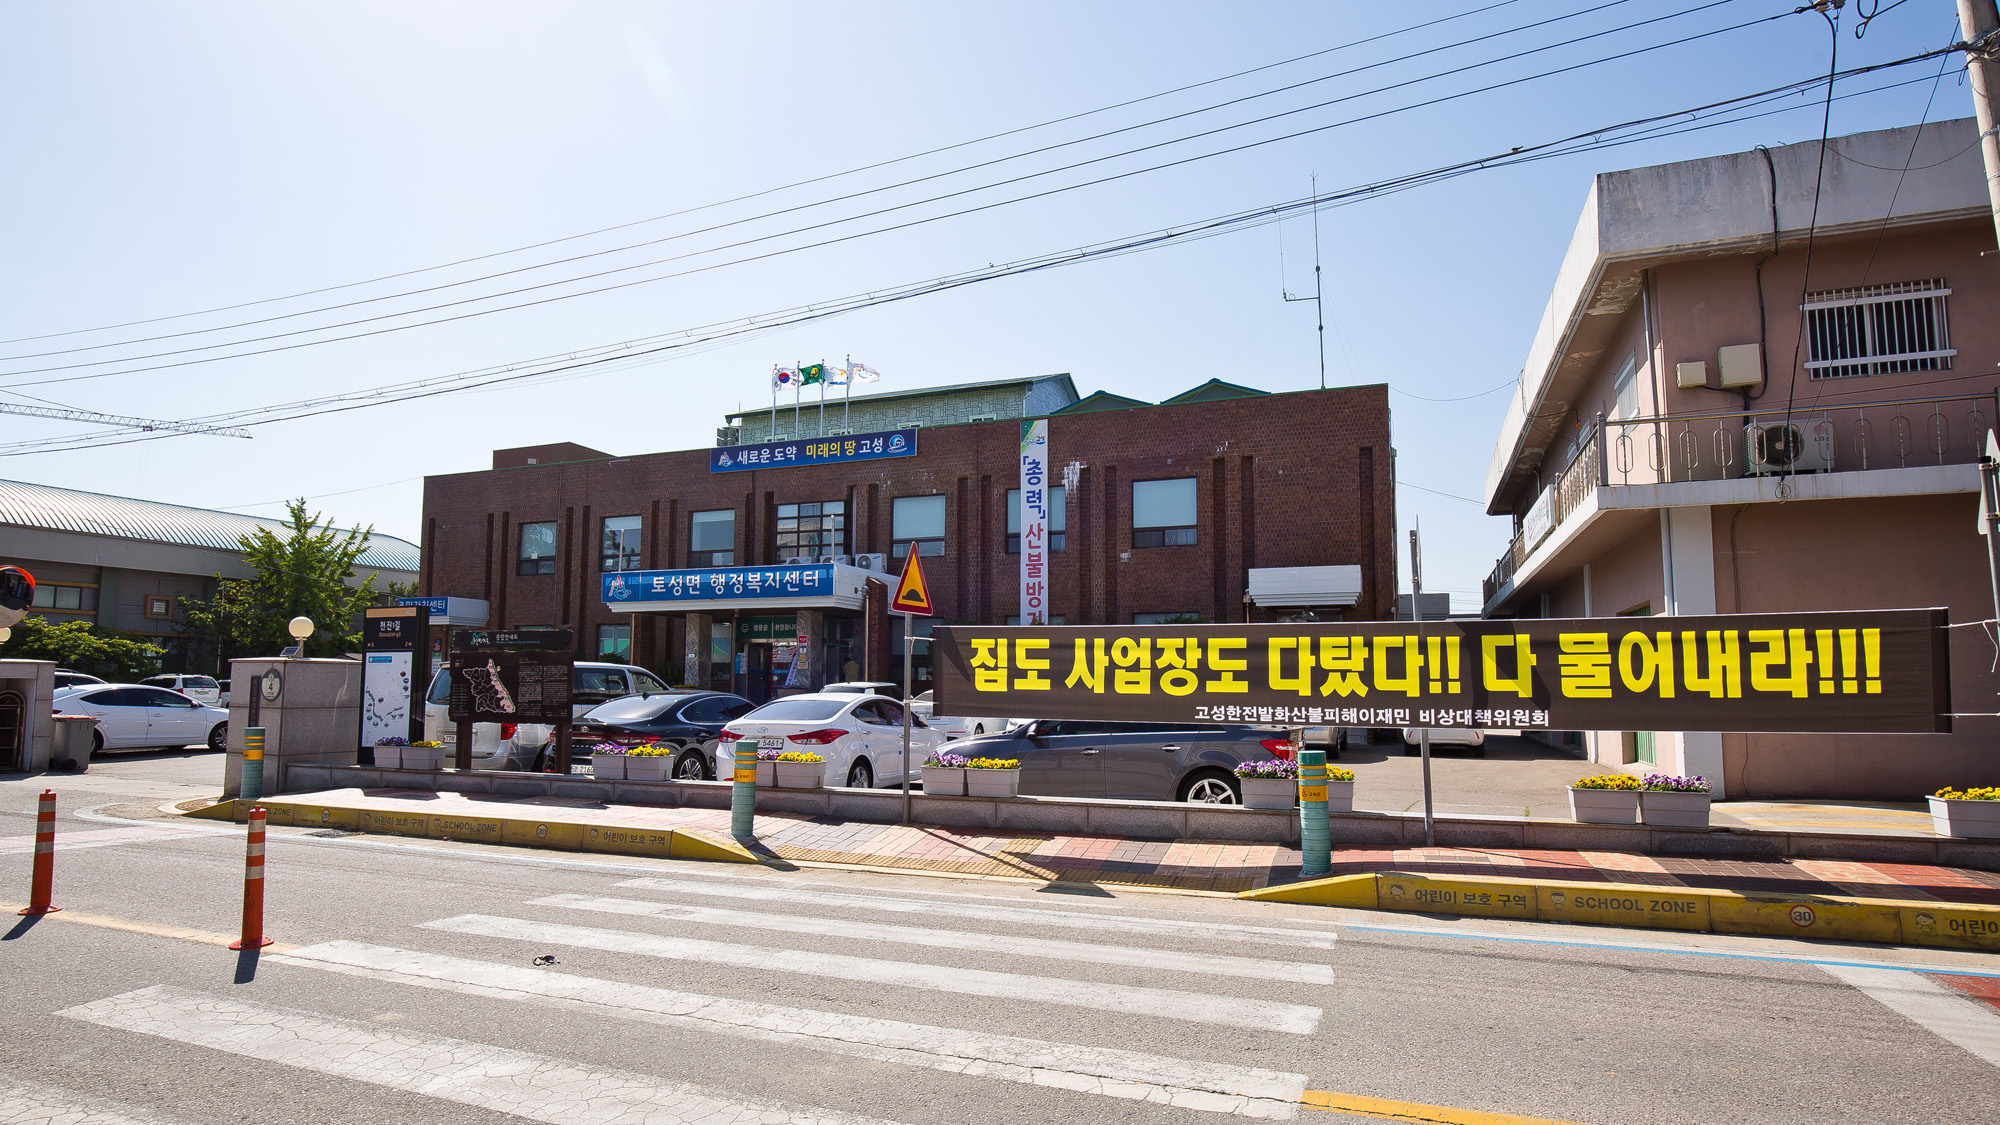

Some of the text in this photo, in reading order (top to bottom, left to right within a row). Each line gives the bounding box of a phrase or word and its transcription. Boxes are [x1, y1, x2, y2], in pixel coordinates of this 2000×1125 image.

[737, 437, 883, 465] 새로운 도약 미래의 땅 고성
[651, 569, 820, 596] 토성면 행정복지센터
[969, 628, 1882, 698] 집도 사업장도 다탔다!! 다 물어내라!!!
[268, 682, 273, 691] 4
[1194, 705, 1550, 727] 고성한전발화산불피해이재민 비상대책위원회
[762, 739, 779, 747] 5461
[273, 807, 291, 816] ZONE
[373, 815, 424, 829] 어린이 보호 구역
[443, 820, 497, 833] SCHOOL ZONE
[538, 827, 547, 836] 30
[603, 830, 666, 847] 어린이 보호 구역
[1414, 888, 1527, 910] 어린이 보호 구역
[1574, 896, 1697, 914] SCHOOL ZONE
[1792, 910, 1812, 922] 30
